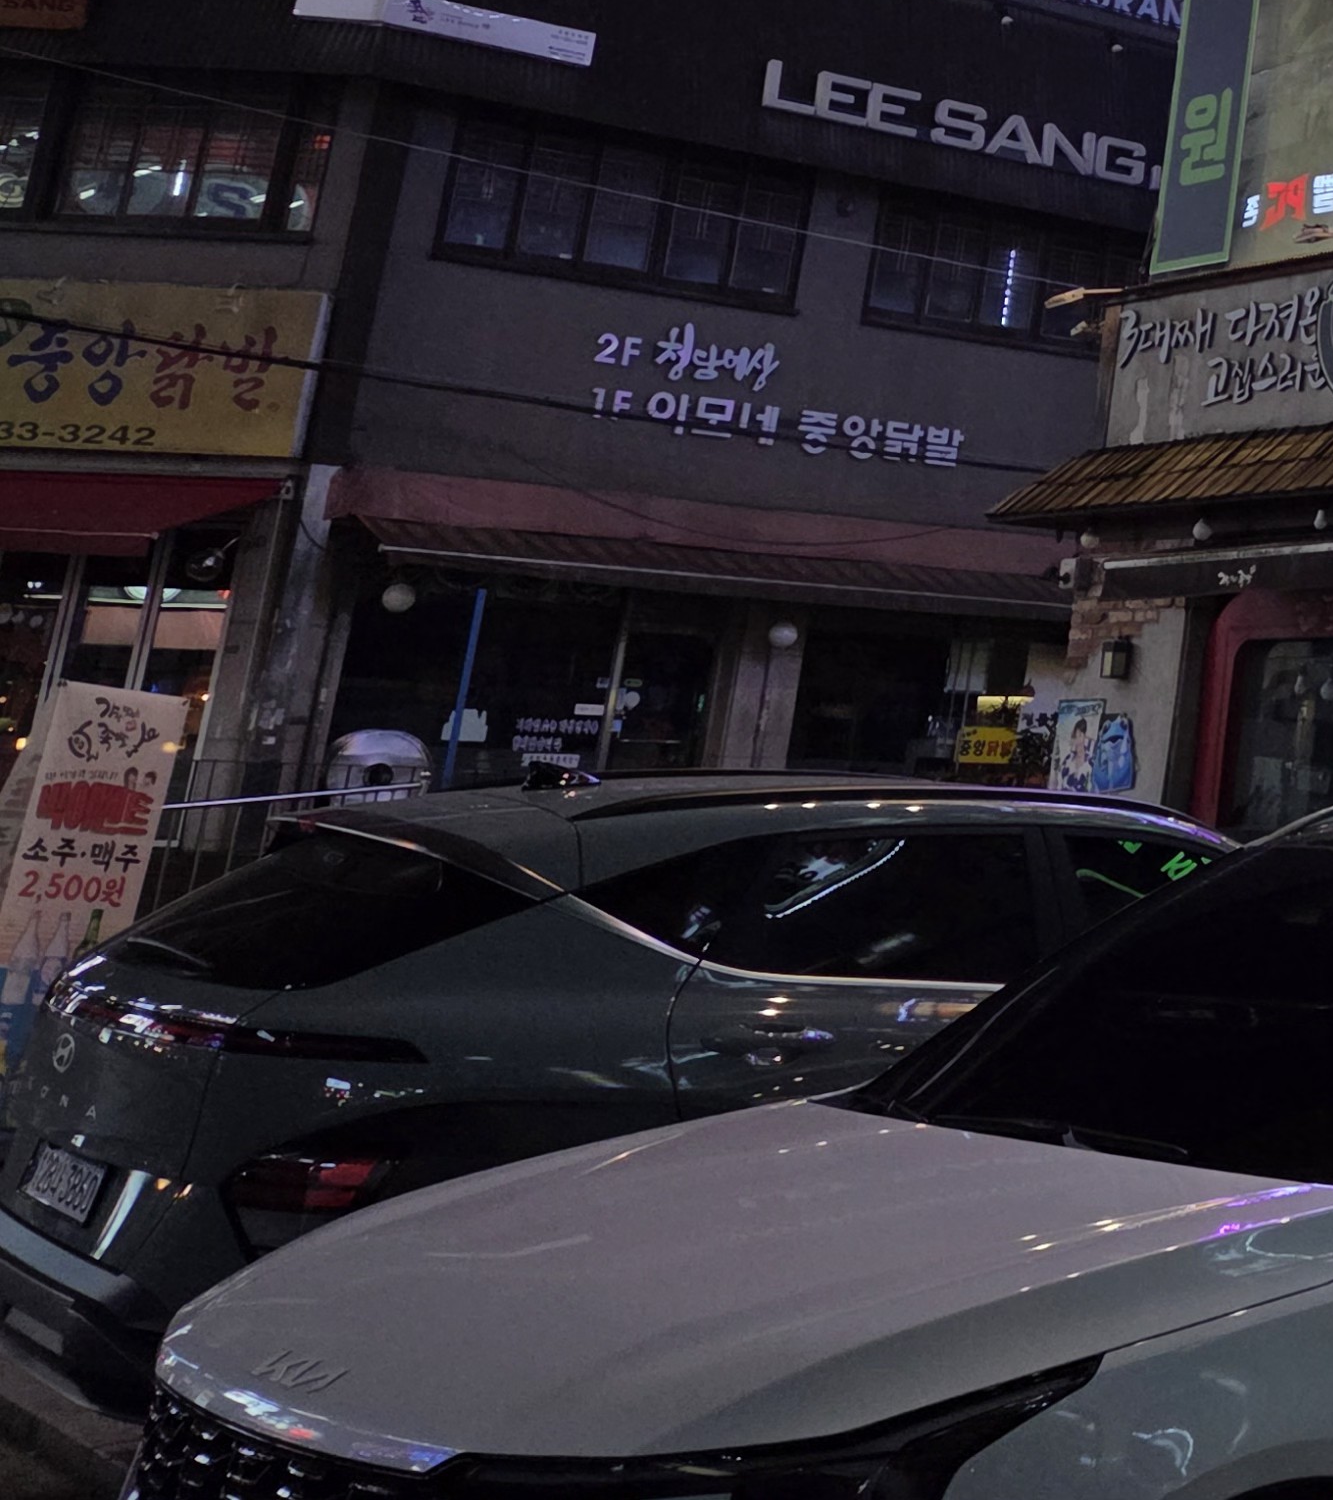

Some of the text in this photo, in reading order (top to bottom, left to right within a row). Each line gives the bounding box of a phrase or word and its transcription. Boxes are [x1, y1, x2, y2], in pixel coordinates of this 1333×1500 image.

[762, 59, 1147, 188] LEE SANG
[594, 332, 640, 366] 2F
[1120, 286, 1321, 369] 3대째 다져온
[1201, 352, 1326, 406] 고집스러운
[646, 390, 781, 447] 이모네
[797, 409, 966, 467] 중앙닭발
[21, 836, 142, 873] 소주·맥주
[17, 869, 127, 909] 2,500원
